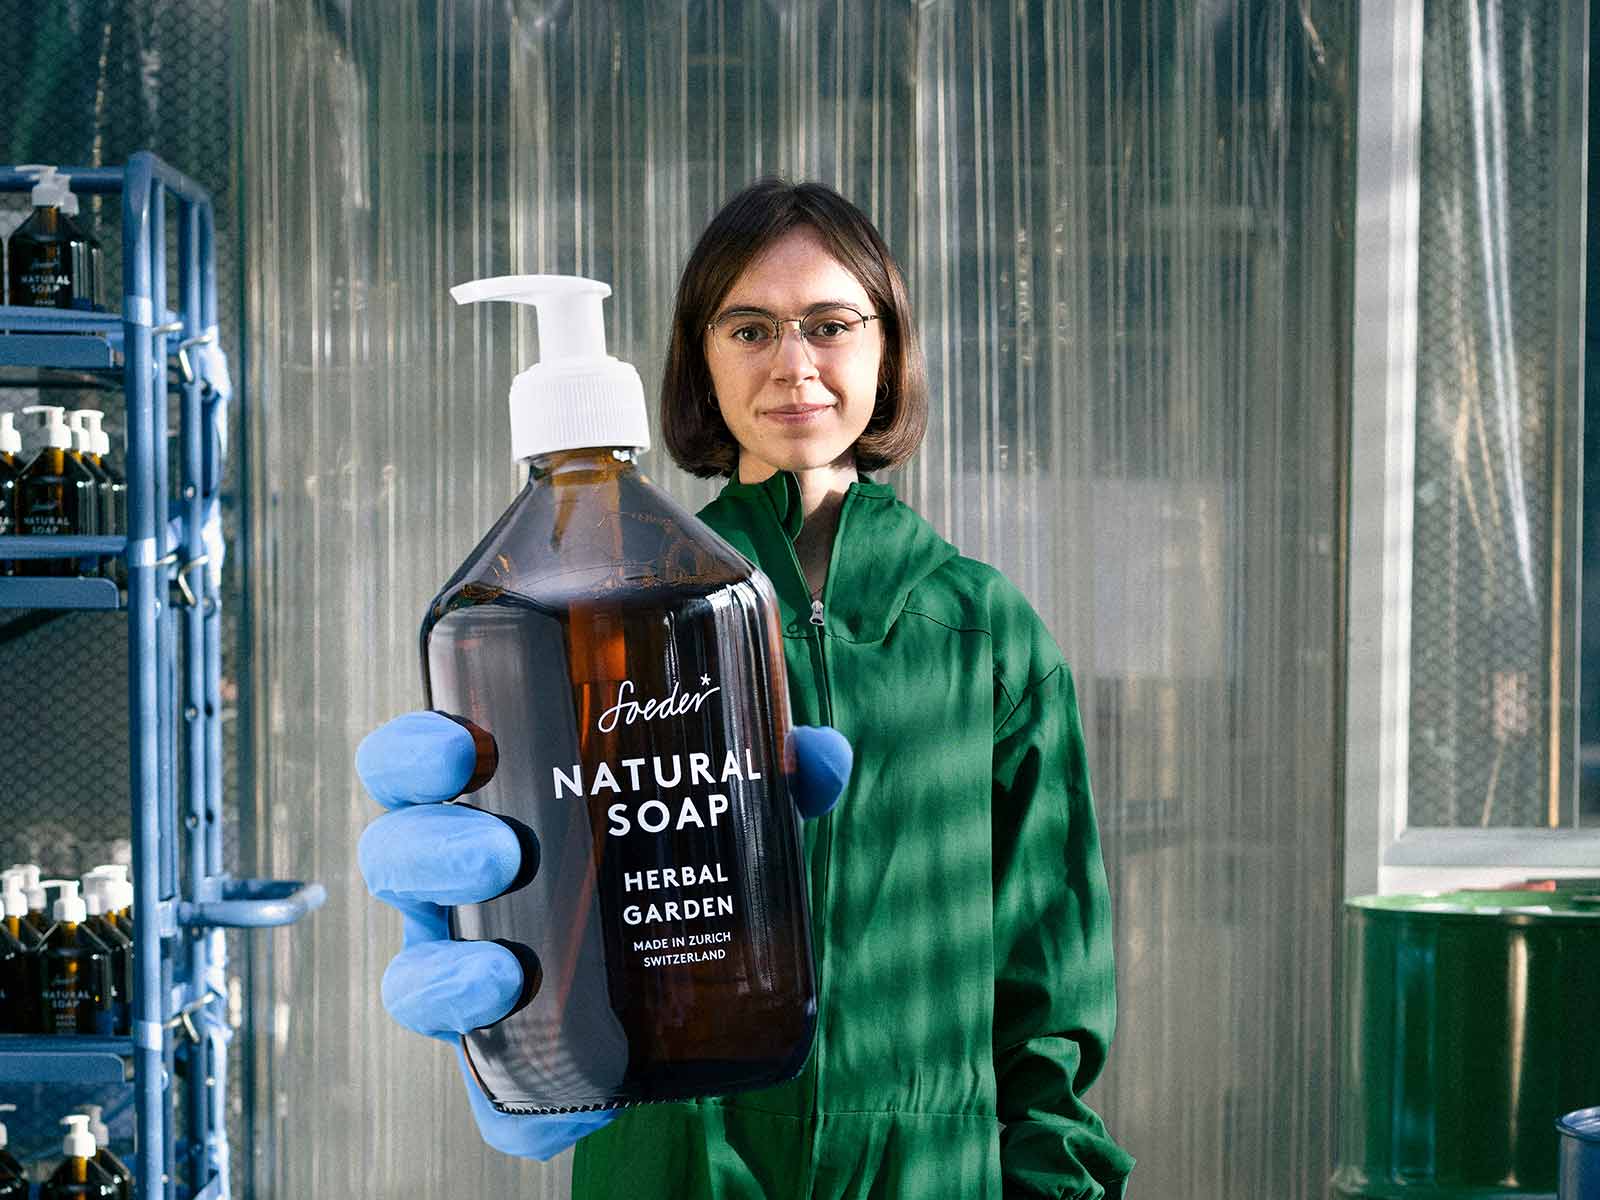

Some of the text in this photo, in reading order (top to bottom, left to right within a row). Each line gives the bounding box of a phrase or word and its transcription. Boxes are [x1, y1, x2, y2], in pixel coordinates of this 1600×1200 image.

[552, 748, 761, 799] NATURAL
[607, 794, 728, 836] SOAP
[623, 863, 729, 892] HERBAL
[623, 895, 733, 925] GARDEN
[633, 931, 731, 952] MADE IN ZURICH
[643, 949, 726, 968] SWITZERLAND
